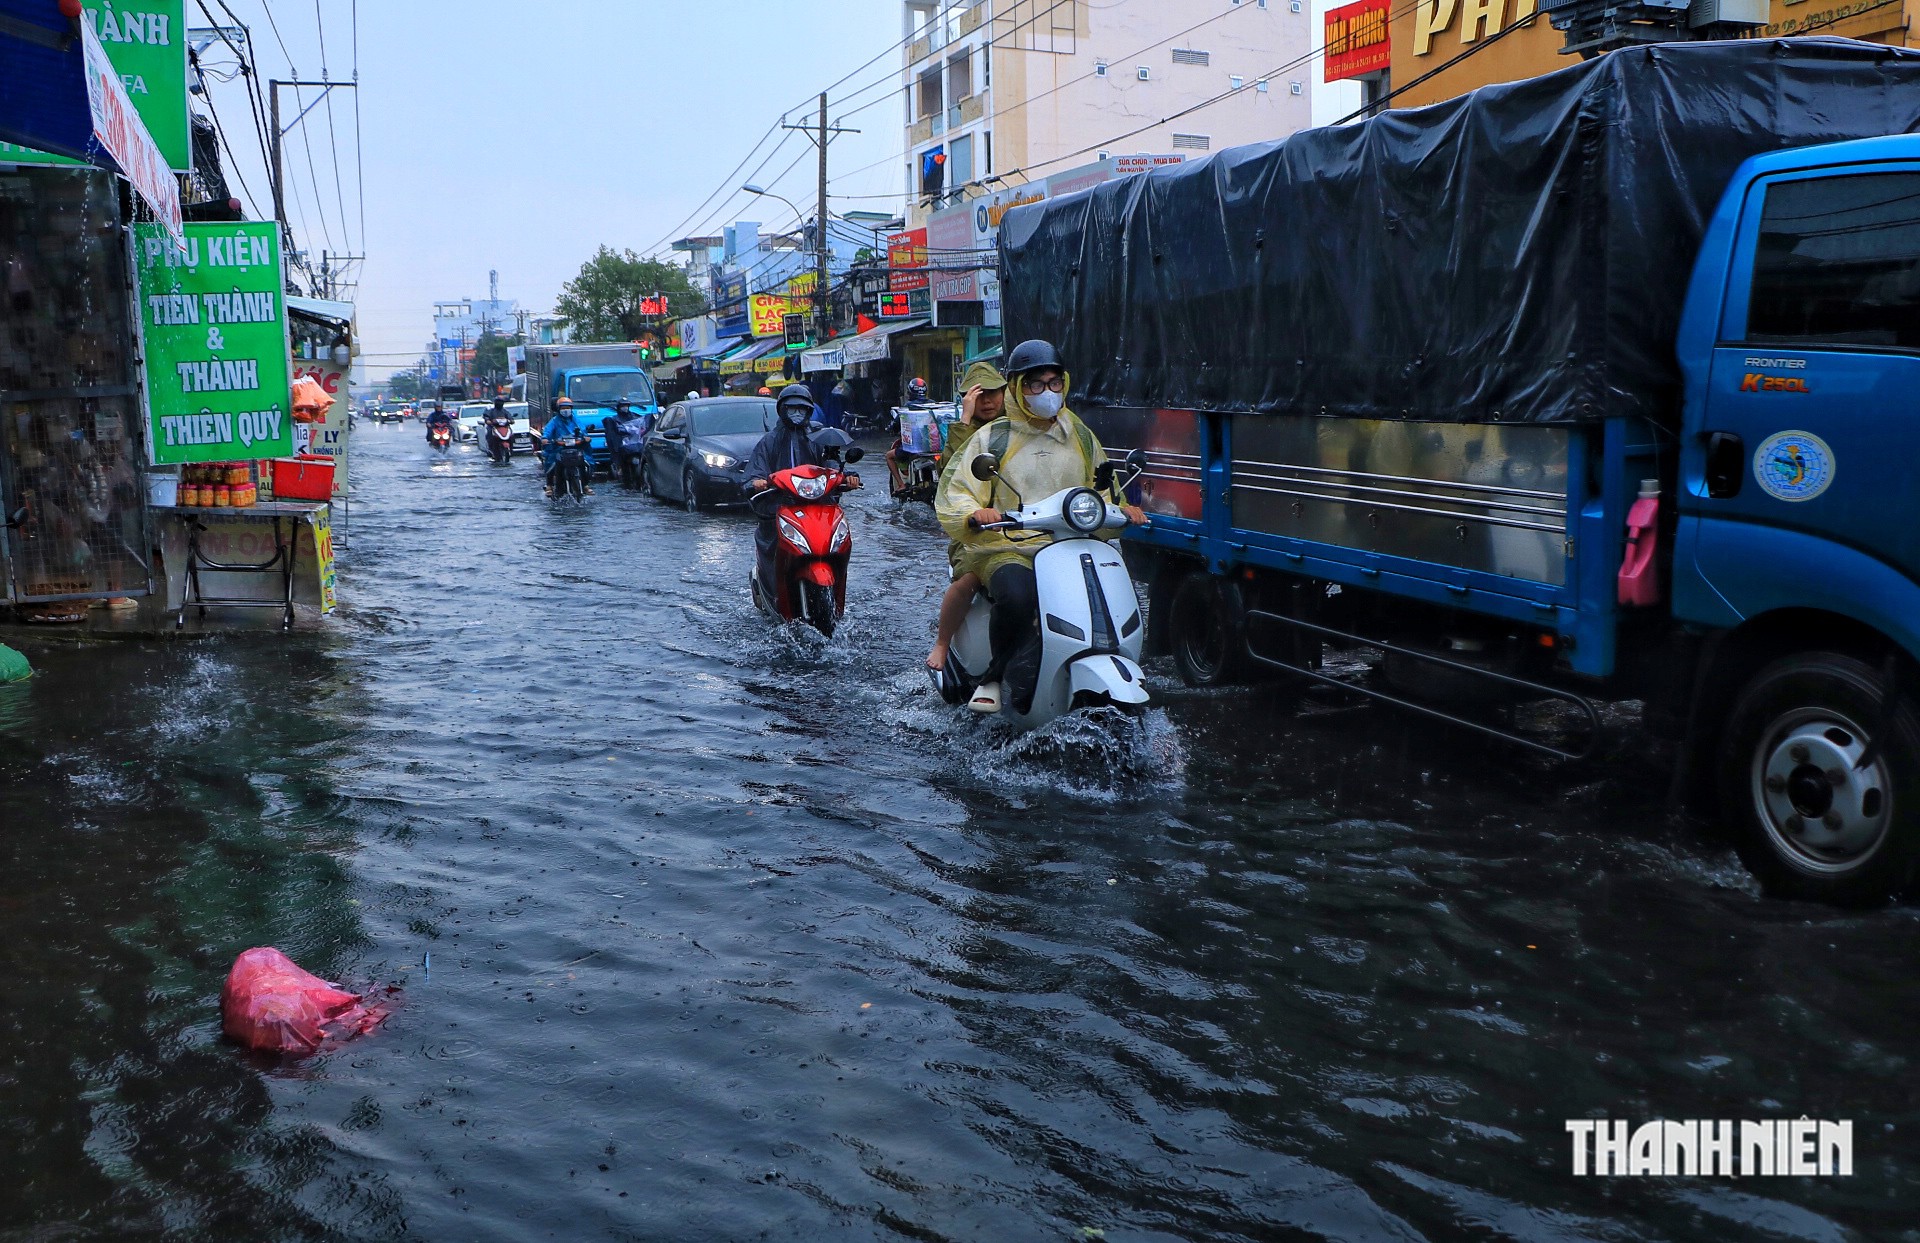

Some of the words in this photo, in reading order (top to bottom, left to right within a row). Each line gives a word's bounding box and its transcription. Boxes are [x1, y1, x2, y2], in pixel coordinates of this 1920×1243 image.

[1326, 16, 1347, 57] VĂN
[1349, 6, 1386, 51] PHÒNG
[1118, 157, 1130, 166] SỬA
[1153, 157, 1168, 165] MUA
[1168, 156, 1182, 164] BÁN
[144, 236, 199, 274] PHỤ
[207, 229, 270, 273] KIỆN
[148, 282, 200, 325] TIẾN
[202, 285, 276, 324] THÀNH
[206, 326, 225, 350] &
[176, 354, 259, 392] THÀNH
[1745, 358, 1807, 369] FRONTIER
[160, 407, 233, 446] THIÊN
[237, 403, 282, 448] QUÝ
[324, 430, 340, 443] LY
